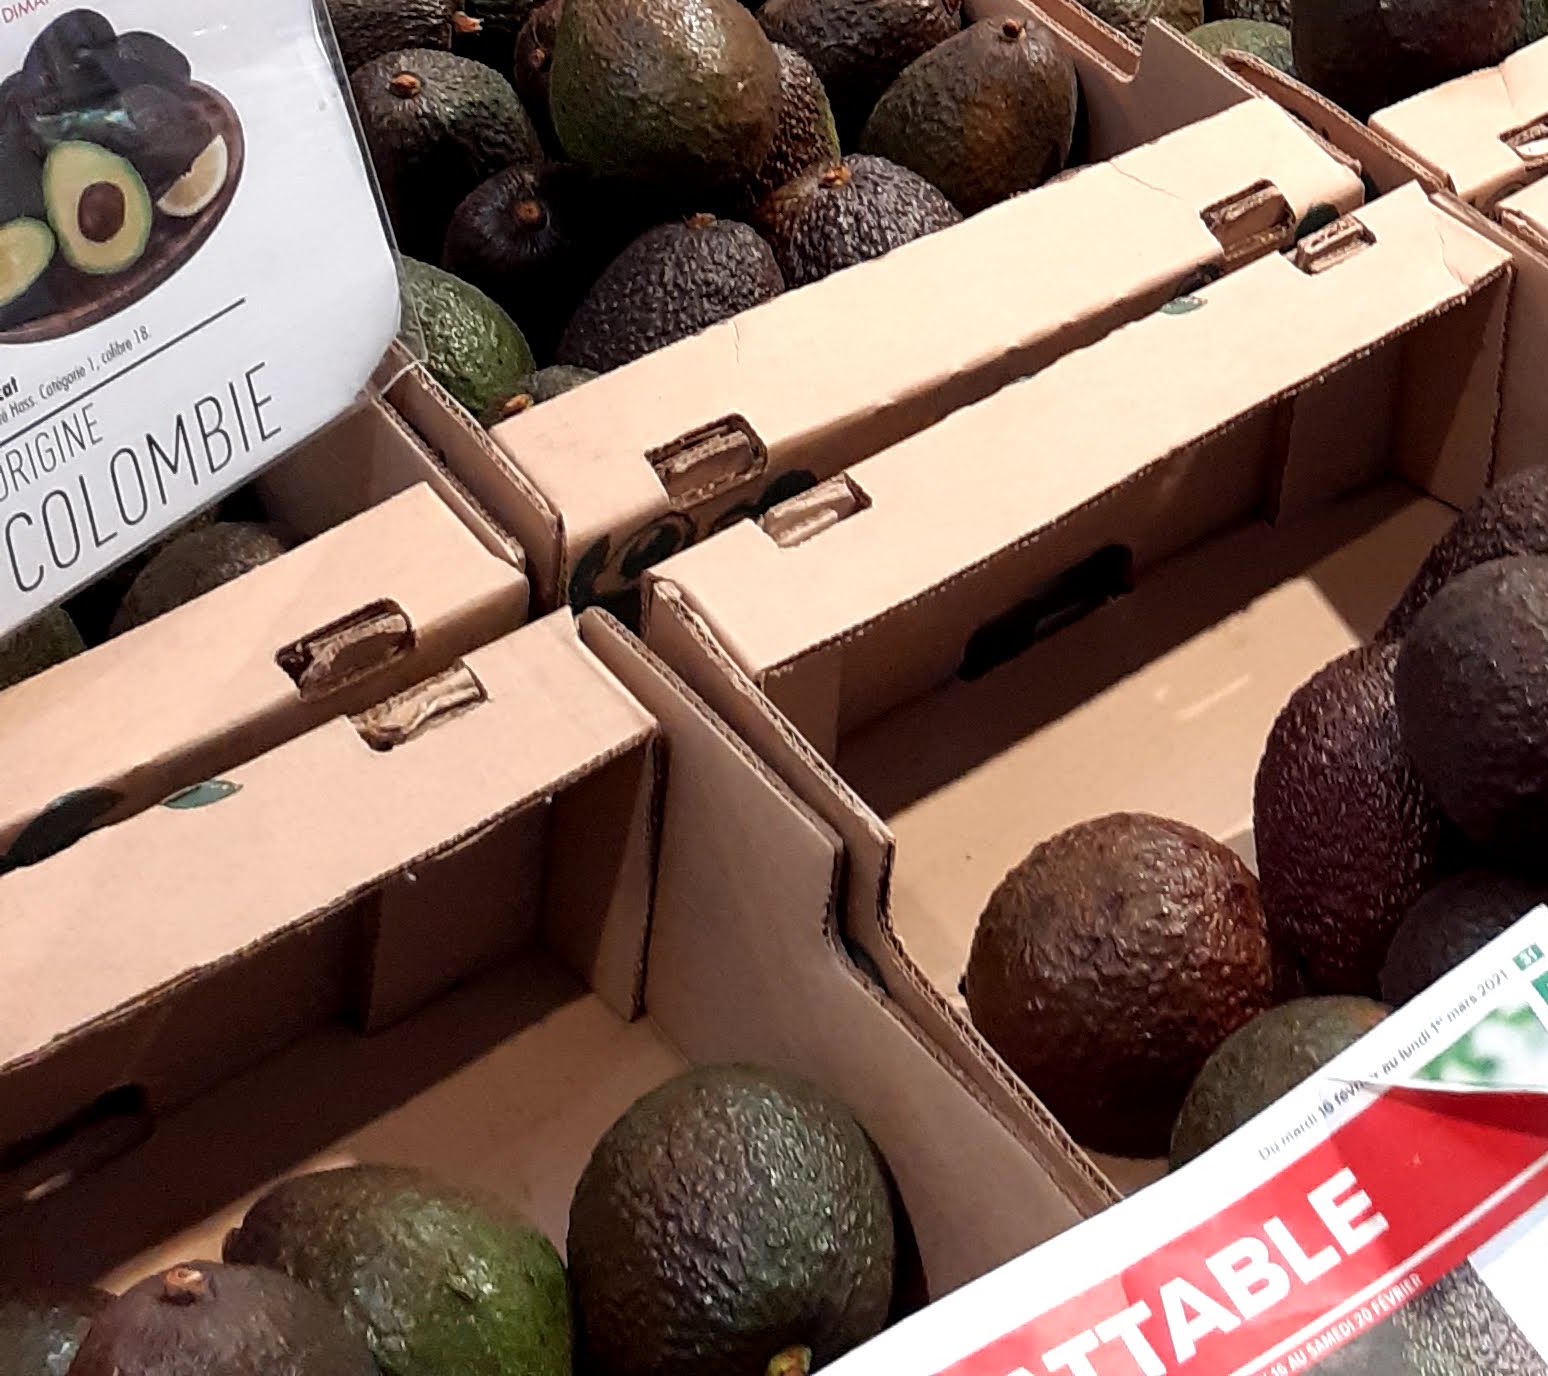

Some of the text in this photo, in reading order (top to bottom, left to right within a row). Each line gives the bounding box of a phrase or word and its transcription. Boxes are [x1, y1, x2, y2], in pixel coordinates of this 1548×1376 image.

[4, 360, 283, 596] COLOMBIE
[1399, 1031, 1430, 1064] lundi
[1445, 996, 1479, 1025] mars
[1478, 968, 1510, 998] 2021
[1287, 1343, 1308, 1367] AU
[1305, 1313, 1358, 1352] SAMEDI
[1355, 1305, 1375, 1327] 20
[1370, 1273, 1424, 1319] FÉVRIER
